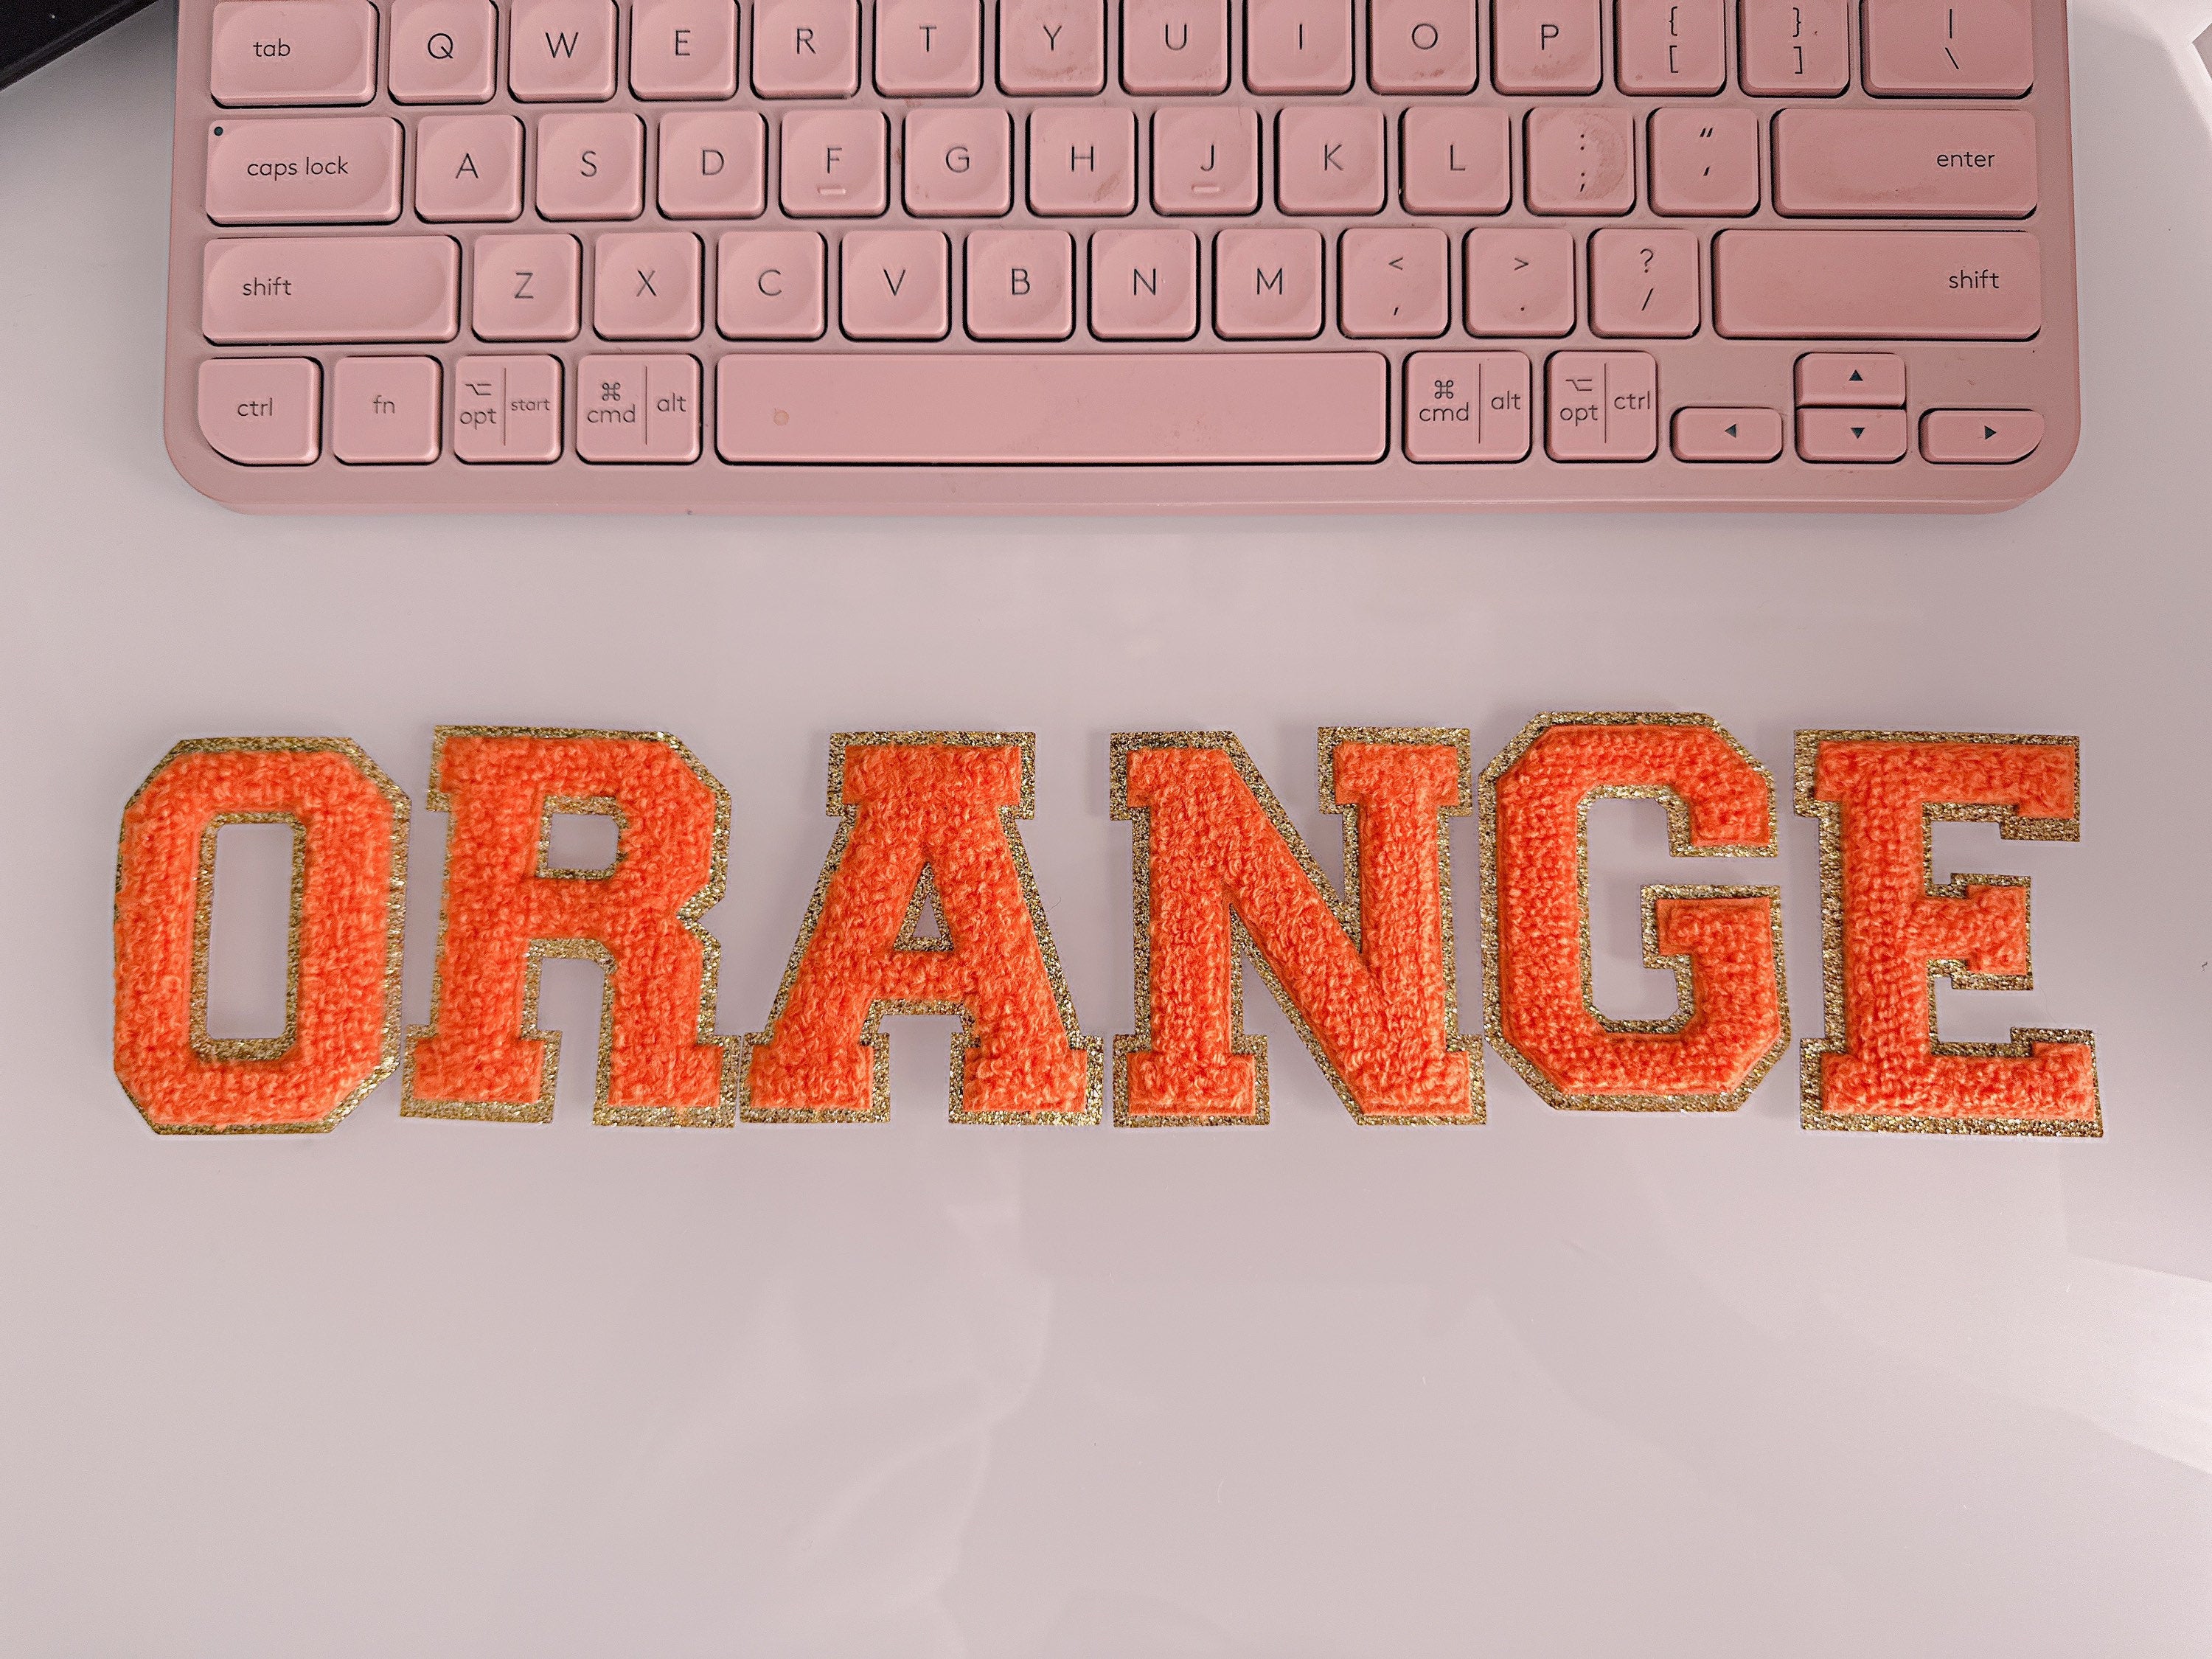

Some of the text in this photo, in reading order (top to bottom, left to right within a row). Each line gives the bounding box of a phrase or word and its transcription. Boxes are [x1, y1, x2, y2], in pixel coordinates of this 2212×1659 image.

[252, 38, 291, 58] tab
[427, 32, 455, 60] Q
[544, 31, 580, 59] W
[675, 29, 691, 57] E
[796, 27, 817, 55] R
[919, 24, 937, 53] T
[1042, 24, 1063, 52] Y
[1164, 22, 1188, 52] U
[1298, 22, 1303, 51] I
[1411, 22, 1439, 51] O
[1540, 23, 1559, 51] P
[246, 156, 349, 181] caps lock
[455, 152, 479, 179] A
[580, 150, 598, 178] S
[701, 148, 725, 177] D
[827, 147, 843, 175] F
[945, 145, 970, 173] G
[1071, 144, 1094, 173] H
[1200, 142, 1215, 173] J
[1324, 142, 1344, 172] K
[1450, 143, 1467, 172] L
[1936, 151, 1996, 168] enter
[242, 276, 293, 296] shift
[513, 271, 535, 299] Z
[636, 269, 658, 297] X
[757, 268, 782, 297] C
[883, 268, 906, 297] V
[1011, 267, 1031, 296] B
[1133, 267, 1157, 296] N
[1256, 267, 1283, 296] M
[1949, 268, 2000, 289] shift
[236, 397, 273, 417] ctrl
[372, 394, 395, 414] fn
[509, 398, 551, 411] start
[586, 403, 636, 424] cmd
[655, 392, 687, 412] alt
[1419, 401, 1470, 422] cmd
[1491, 390, 1521, 411] alt
[1613, 390, 1651, 410] ctrl
[459, 408, 497, 431] opt
[1559, 404, 1599, 427] opt
[114, 711, 2103, 1135] ORANGE
